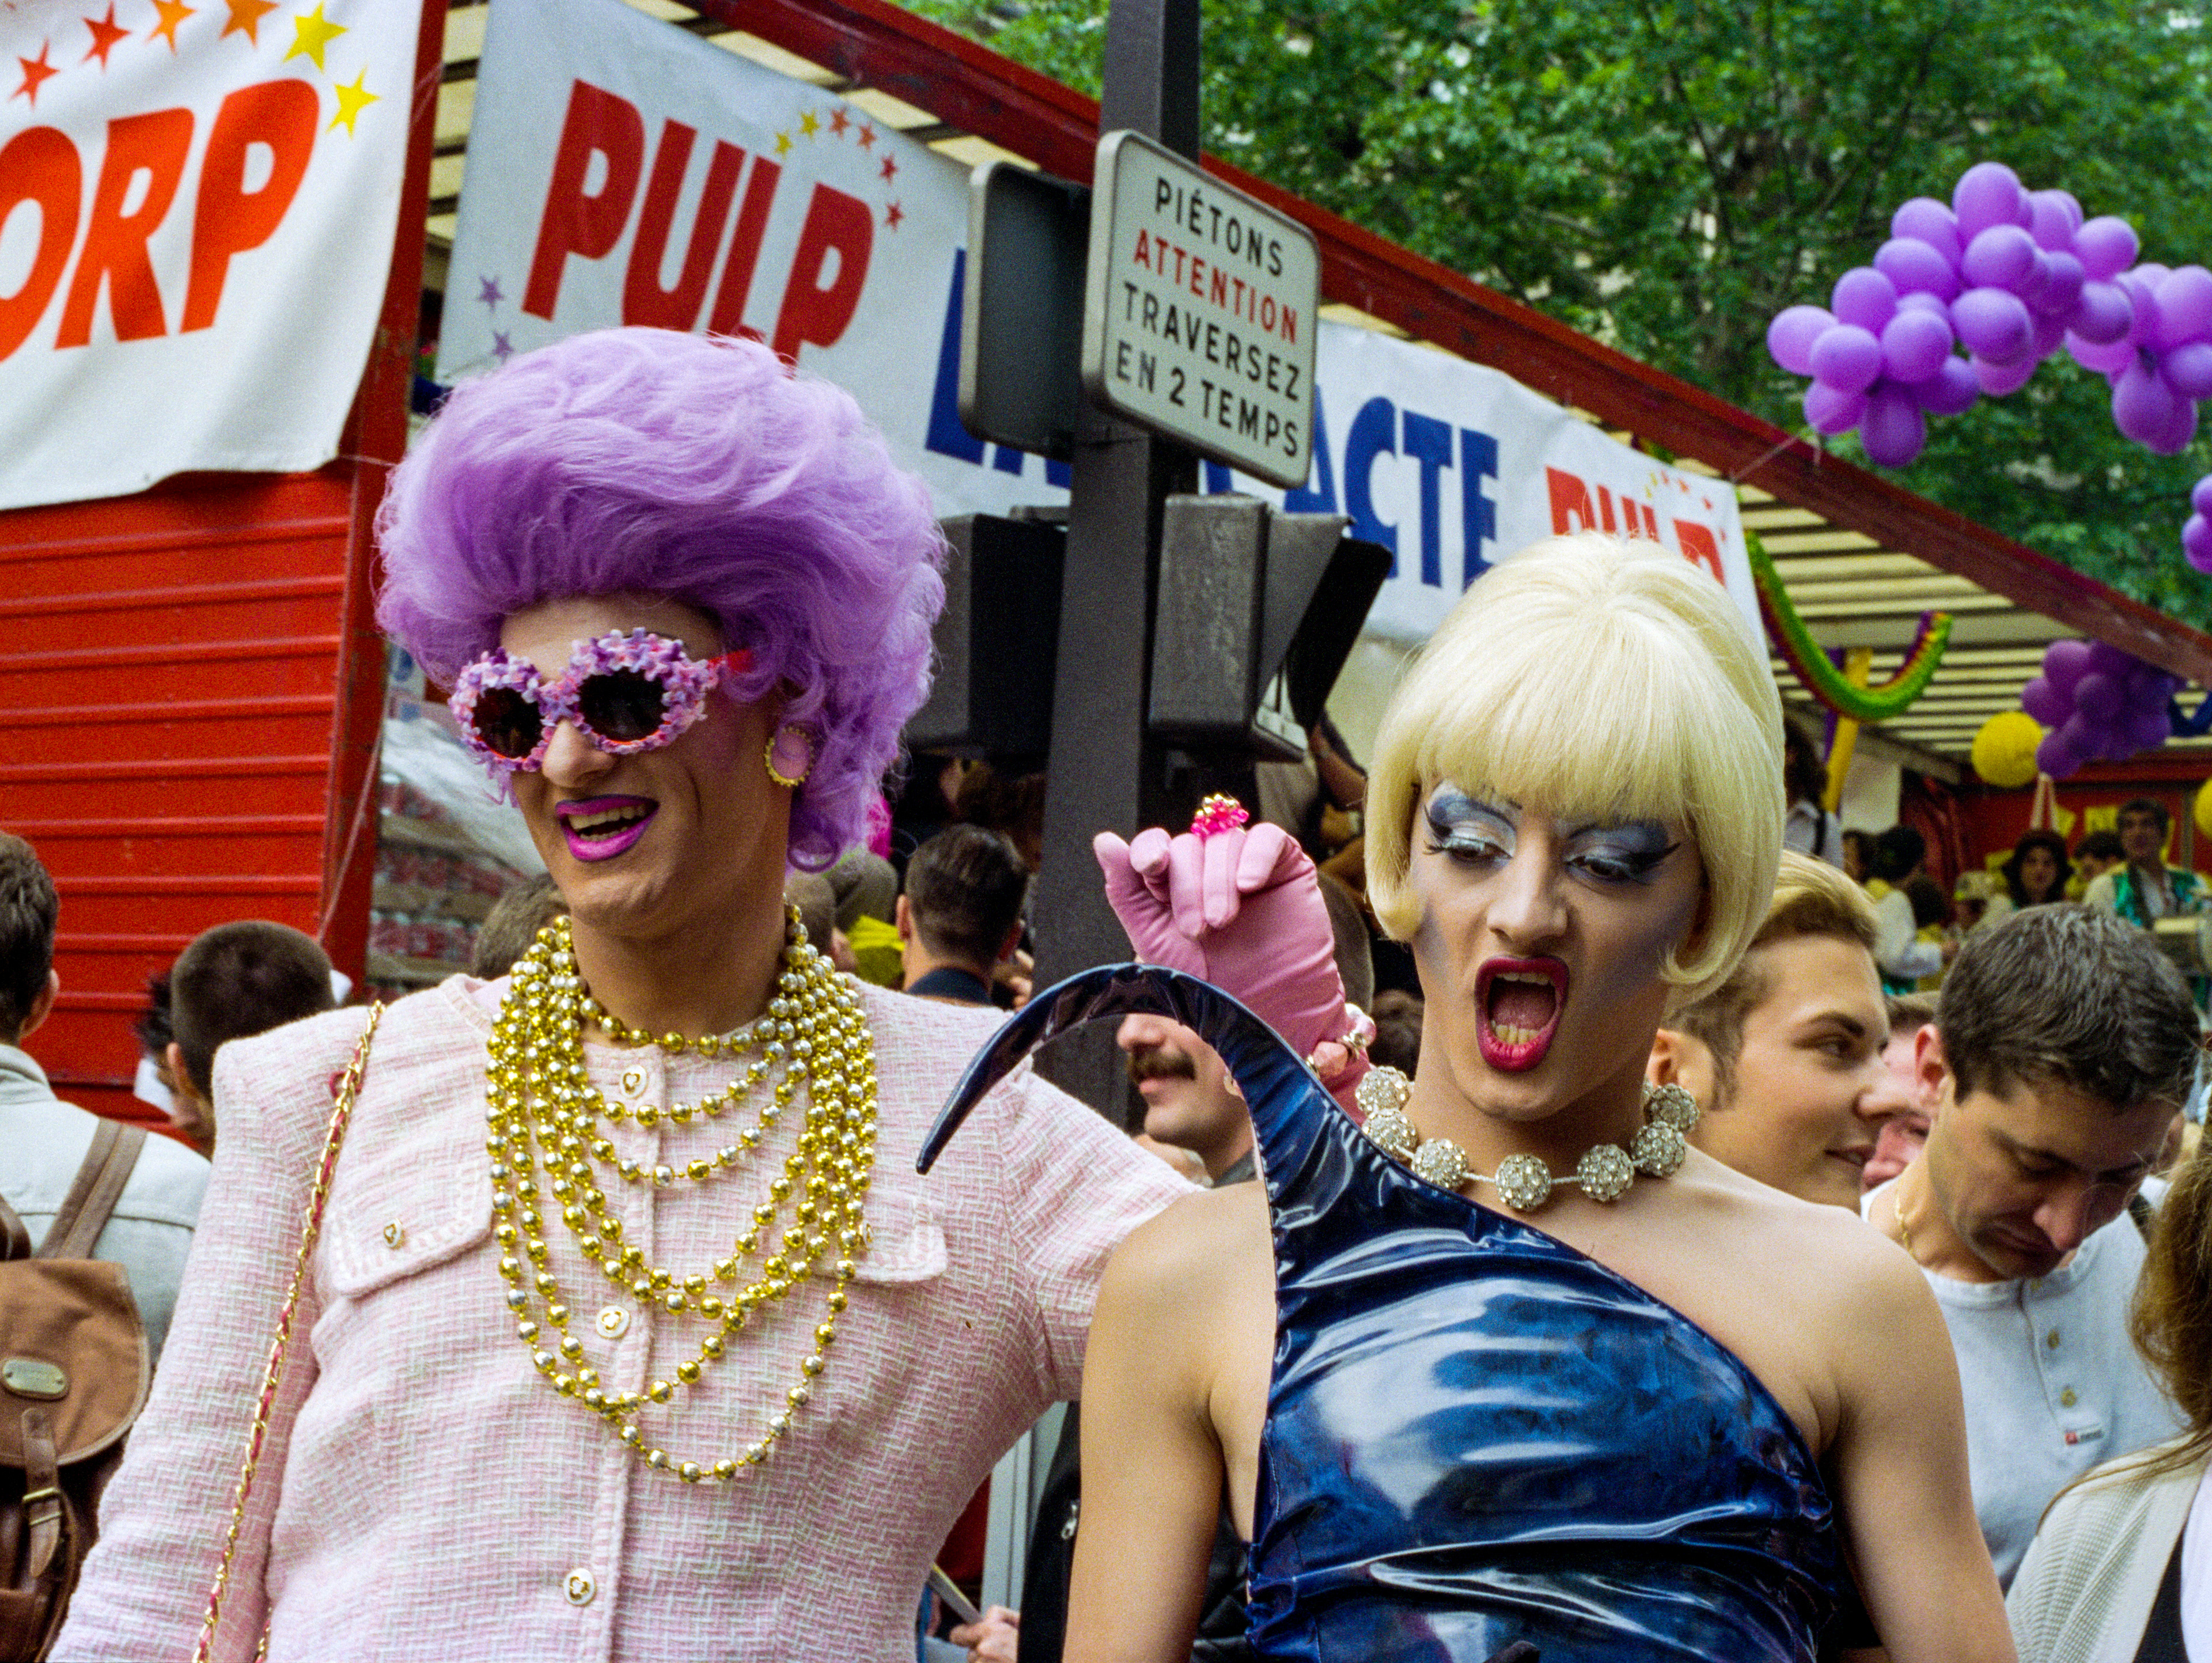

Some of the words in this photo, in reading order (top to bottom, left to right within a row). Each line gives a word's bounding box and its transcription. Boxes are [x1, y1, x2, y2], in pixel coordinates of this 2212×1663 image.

[521, 77, 874, 380] PULP
[1132, 228, 1297, 344] ATTENTION
[1156, 176, 1282, 277] PIÉTONS
[1116, 339, 1156, 394] EN
[1169, 366, 1186, 407] 2
[1202, 378, 1298, 458] TEMPS
[1124, 280, 1300, 402] TRAVERSEZ
